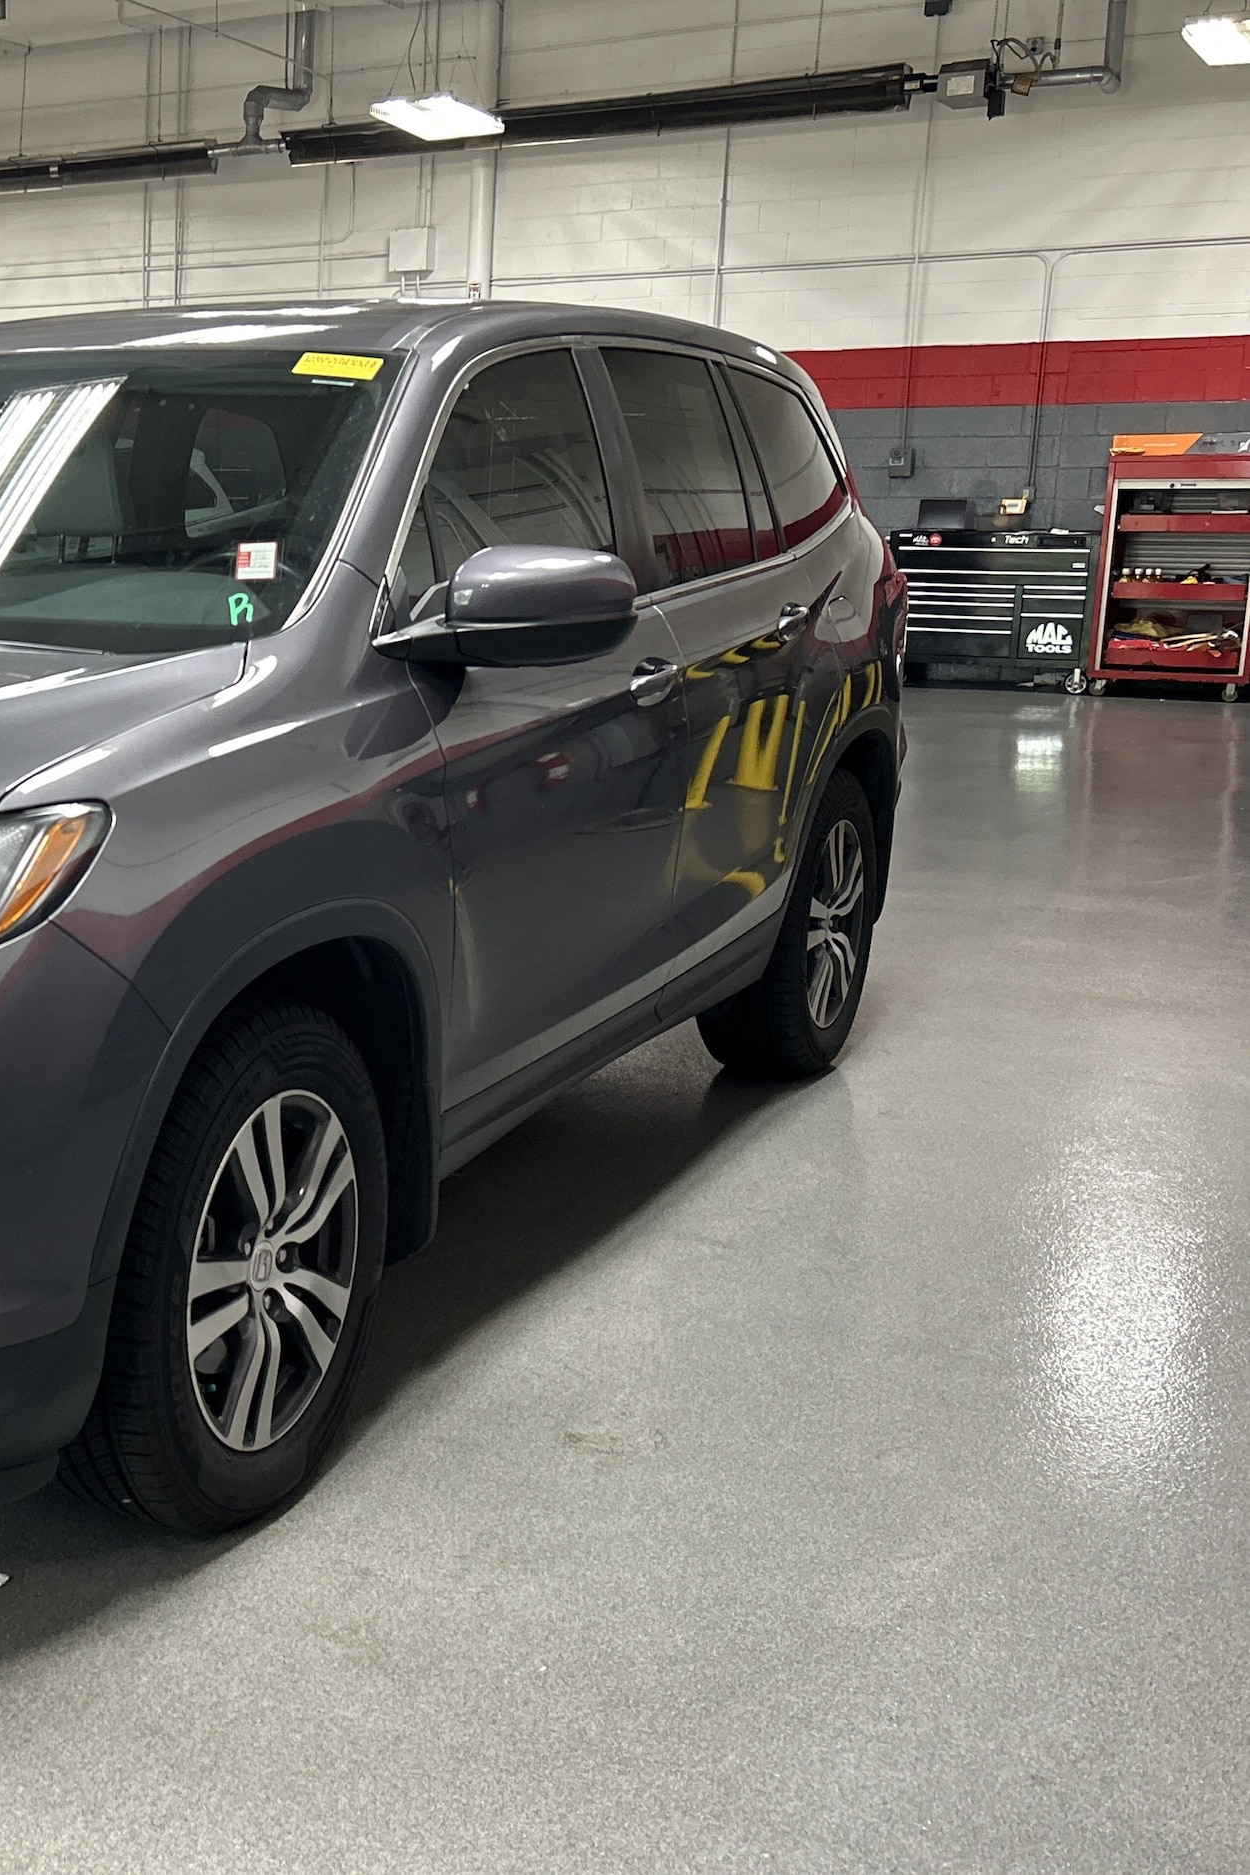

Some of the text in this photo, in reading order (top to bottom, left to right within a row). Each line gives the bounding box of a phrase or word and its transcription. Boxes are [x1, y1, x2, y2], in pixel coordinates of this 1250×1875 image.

[1004, 534, 1029, 544] Tech
[1025, 622, 1073, 645] MAC
[1025, 644, 1072, 654] TOOLS
